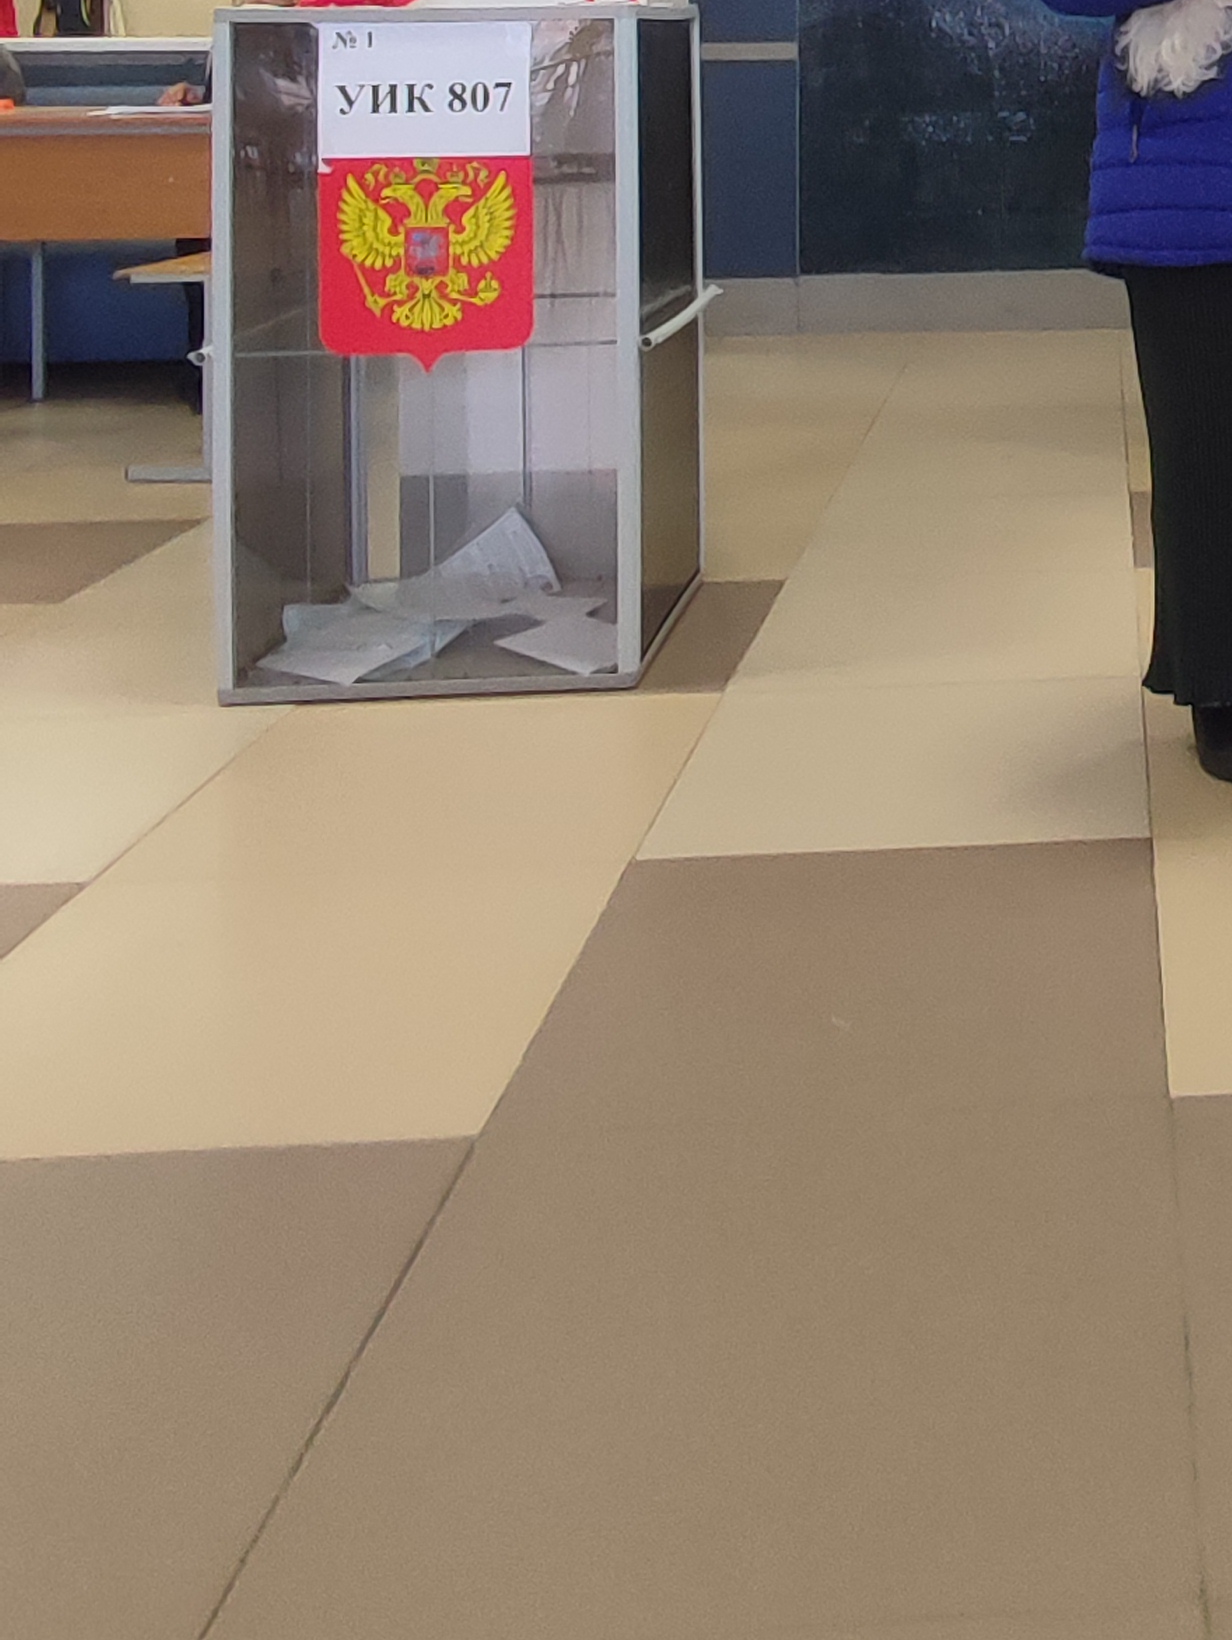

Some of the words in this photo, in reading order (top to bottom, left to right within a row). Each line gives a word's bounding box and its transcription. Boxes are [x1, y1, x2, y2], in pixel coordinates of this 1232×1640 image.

[366, 31, 373, 48] 1
[335, 83, 434, 115] УИК
[447, 82, 512, 112] 807
